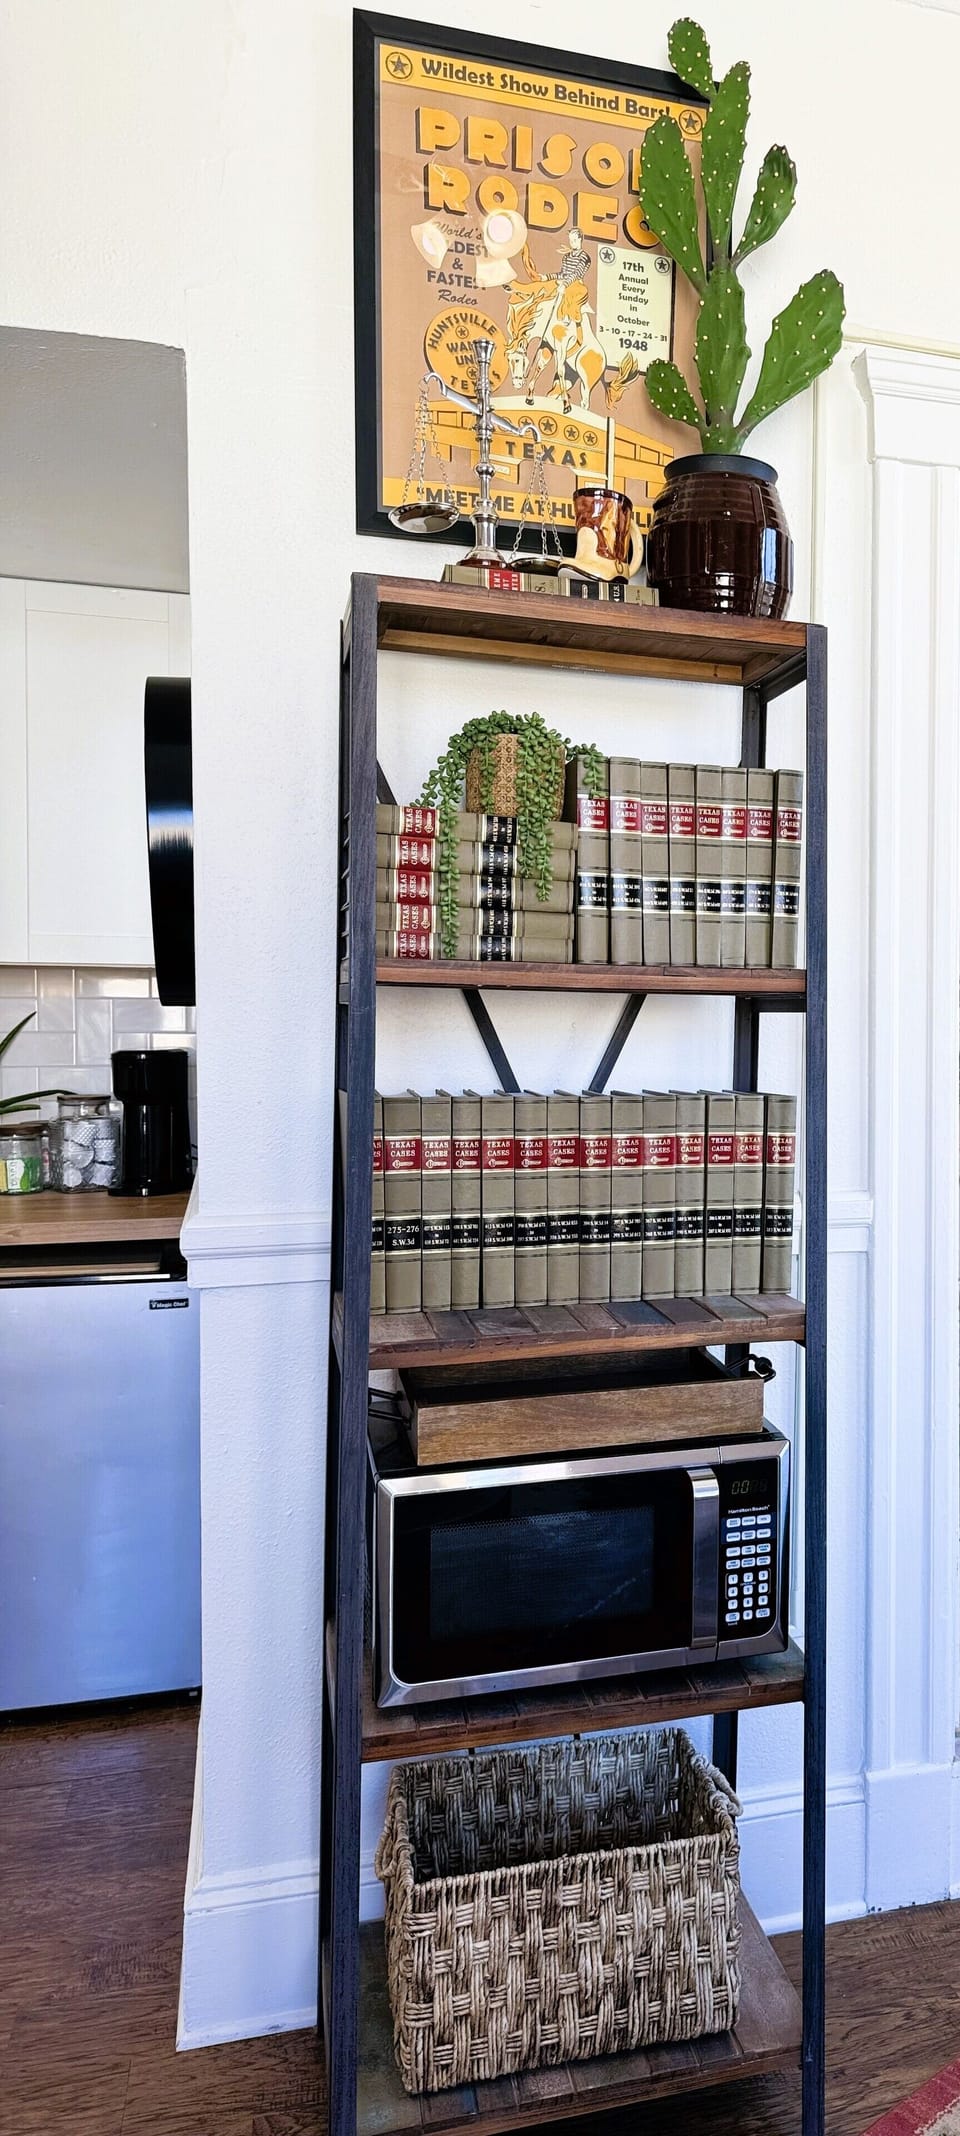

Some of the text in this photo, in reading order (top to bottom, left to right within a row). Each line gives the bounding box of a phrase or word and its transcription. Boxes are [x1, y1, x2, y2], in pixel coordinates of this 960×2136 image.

[421, 57, 494, 87] Wildest
[500, 73, 549, 97] Show
[554, 84, 620, 112] Behind
[452, 257, 463, 270] &
[622, 261, 645, 273] 17th
[618, 273, 649, 285] Annual
[621, 283, 646, 295] Every
[437, 289, 479, 306] Rodeo
[618, 293, 649, 305] Sunday
[629, 304, 638, 312] in
[617, 315, 650, 327] October
[427, 312, 498, 350] HUNTSVILLE
[618, 337, 648, 351] 1948
[505, 440, 588, 467] TEXAS
[582, 800, 606, 808] TEXAS
[615, 801, 638, 810] TEXAS
[582, 808, 605, 816] CASES
[643, 805, 666, 813] TEXAS
[670, 806, 693, 814] TEXAS
[699, 808, 720, 816] TEXAS
[722, 809, 745, 817] TEXAS
[615, 810, 637, 818] CASES
[644, 814, 666, 822] CASES
[749, 810, 772, 818] TEXAS
[405, 808, 414, 833] TEXAS
[414, 809, 423, 834] CASES
[723, 818, 745, 826] CASES
[750, 819, 771, 827] CASES
[401, 840, 409, 865] TEXAS
[410, 841, 418, 866] CASES
[399, 874, 407, 899] TEXAS
[409, 875, 417, 899] CASES
[402, 904, 410, 930] TEXAS
[411, 905, 419, 930] CASES
[399, 933, 407, 957] TEXAS
[409, 934, 417, 957] CASES
[389, 1140, 416, 1148] TEXAS
[423, 1141, 449, 1149] TEXAS
[551, 1139, 576, 1147] TEXAS
[616, 1139, 640, 1147] TEXAS
[648, 1138, 671, 1146] TEXAS
[679, 1137, 702, 1145] TEXAS
[584, 1148, 608, 1156] CASES
[616, 1147, 639, 1155] CASES
[680, 1145, 702, 1153] CASES
[739, 1144, 761, 1152] CASES
[390, 1149, 416, 1157] CASES
[424, 1150, 449, 1158] CASES
[454, 1149, 479, 1157] CASES
[487, 1149, 510, 1157] CASES
[520, 1149, 543, 1157] CASES
[387, 1225, 420, 1235] 275-276
